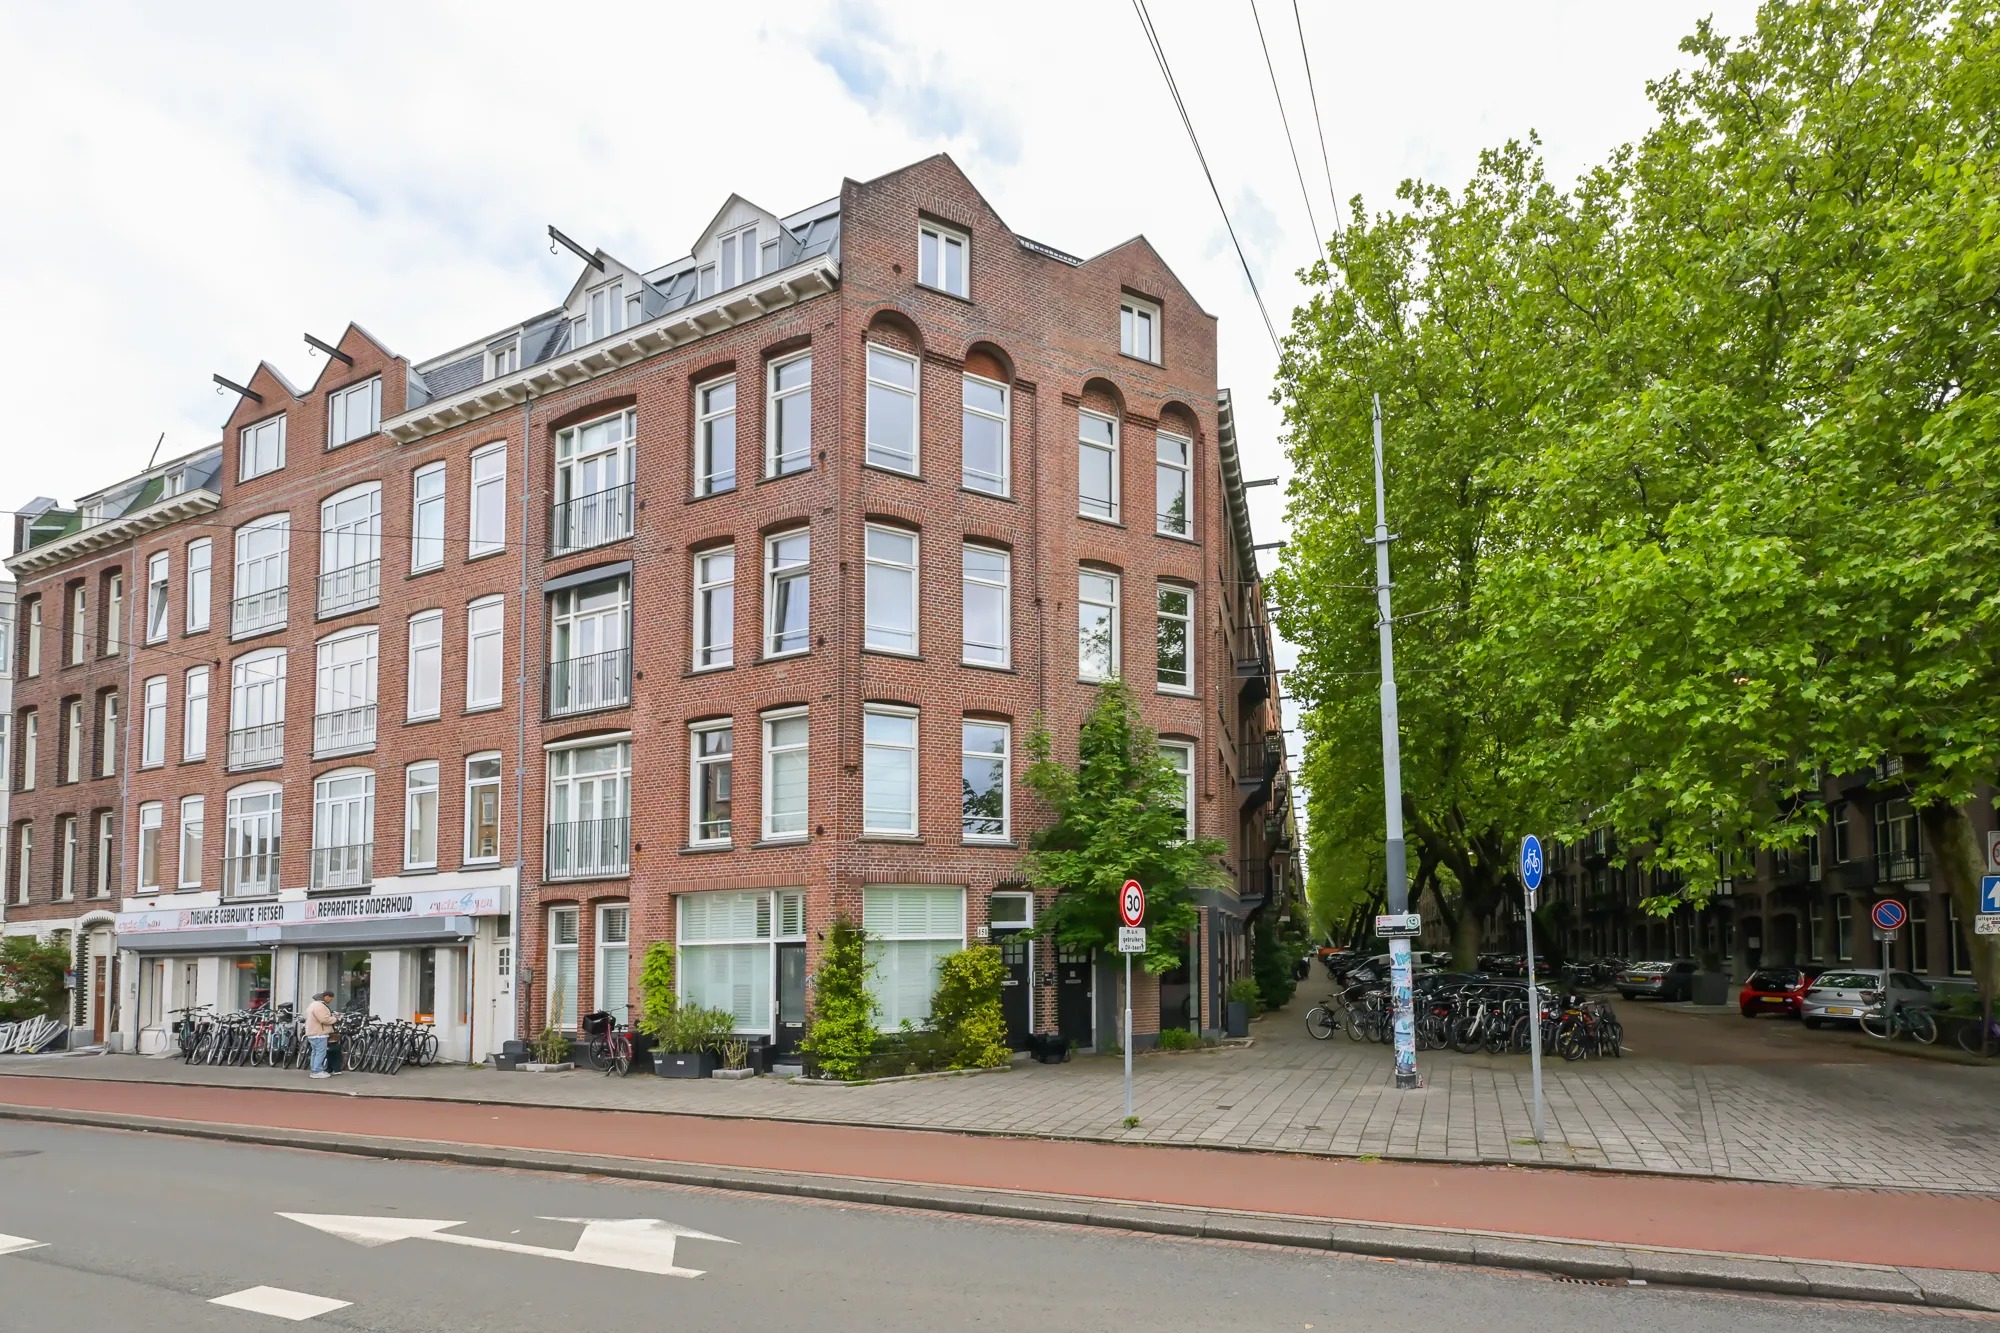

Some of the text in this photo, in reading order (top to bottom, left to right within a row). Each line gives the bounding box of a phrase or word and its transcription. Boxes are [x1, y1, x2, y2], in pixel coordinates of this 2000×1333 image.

[317, 896, 413, 917] REPARATIE & ONDERHOUD
[1126, 894, 1140, 912] 30
[190, 904, 284, 926] NIEUWE & GEBRUIKTE FIETSEN
